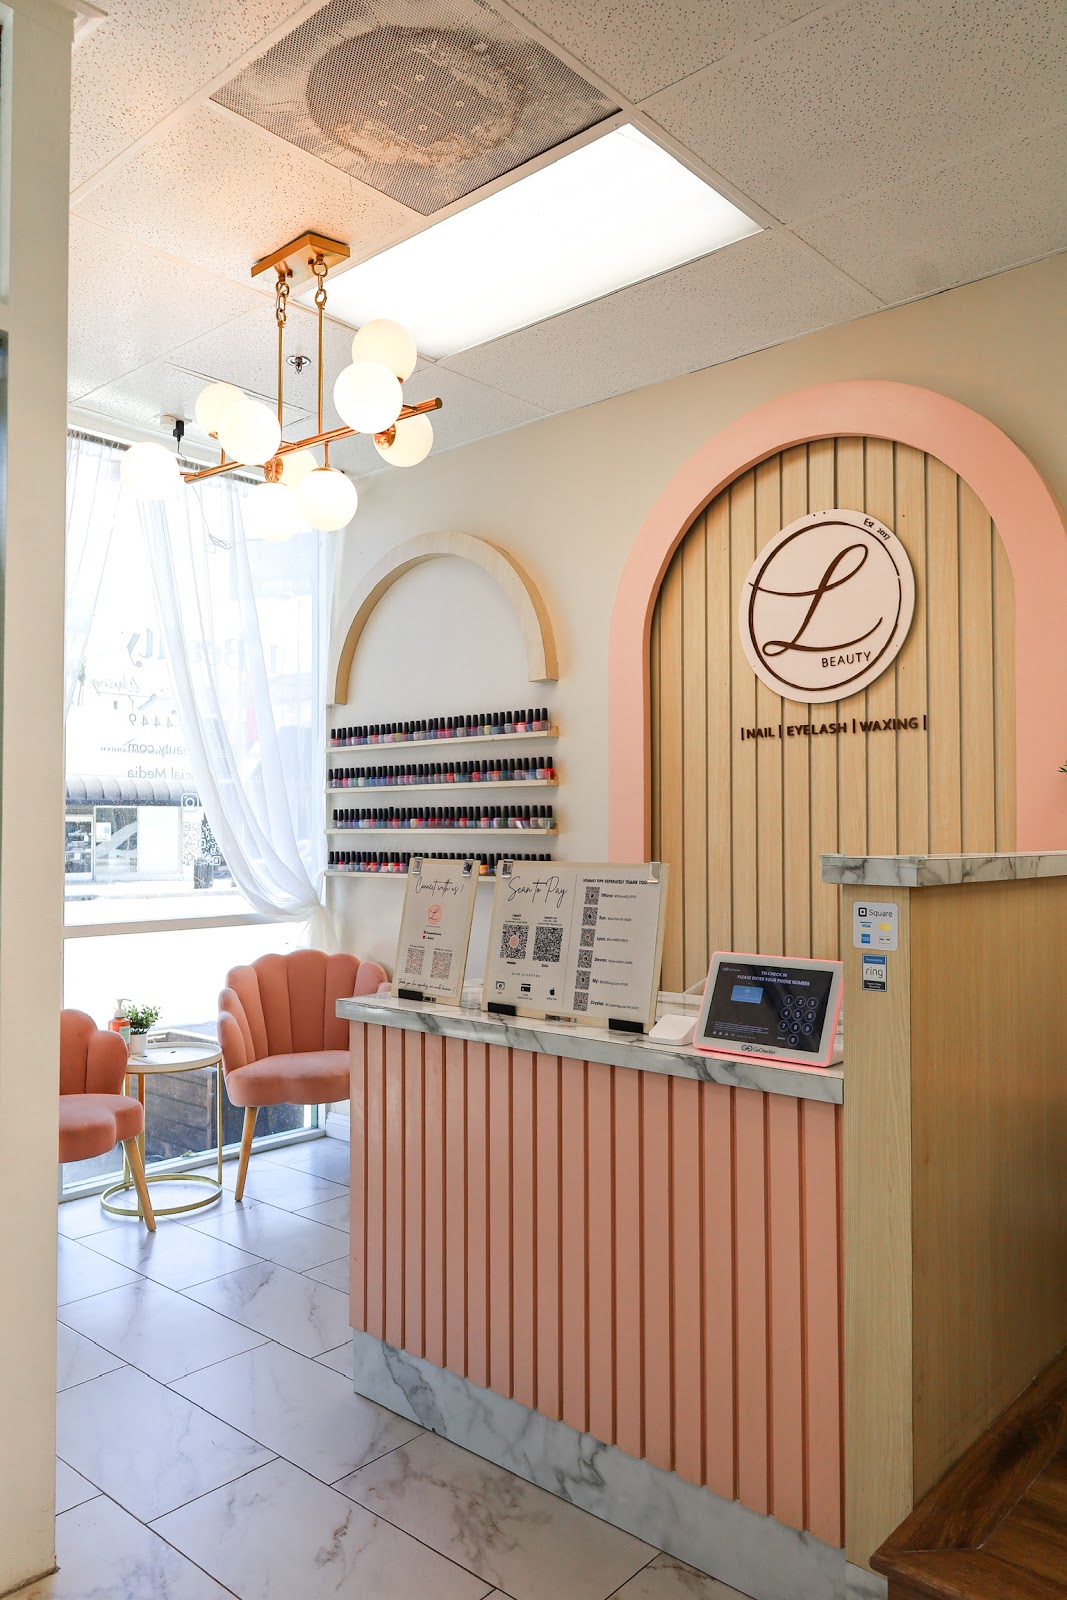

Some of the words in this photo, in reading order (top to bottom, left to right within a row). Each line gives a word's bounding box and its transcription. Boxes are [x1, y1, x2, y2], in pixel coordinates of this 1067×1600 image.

[877, 528, 890, 540] 2017
[749, 544, 883, 656] L
[822, 651, 871, 668] BEAUTY
[746, 727, 774, 738] NAIL
[787, 722, 846, 736] EYELASH
[860, 717, 918, 731] WAXING
[416, 876, 440, 896] Connect
[508, 876, 532, 901] Scan
[532, 879, 546, 903] to
[545, 876, 568, 908] Pay
[869, 909, 893, 918] Square
[866, 967, 883, 978] ring
